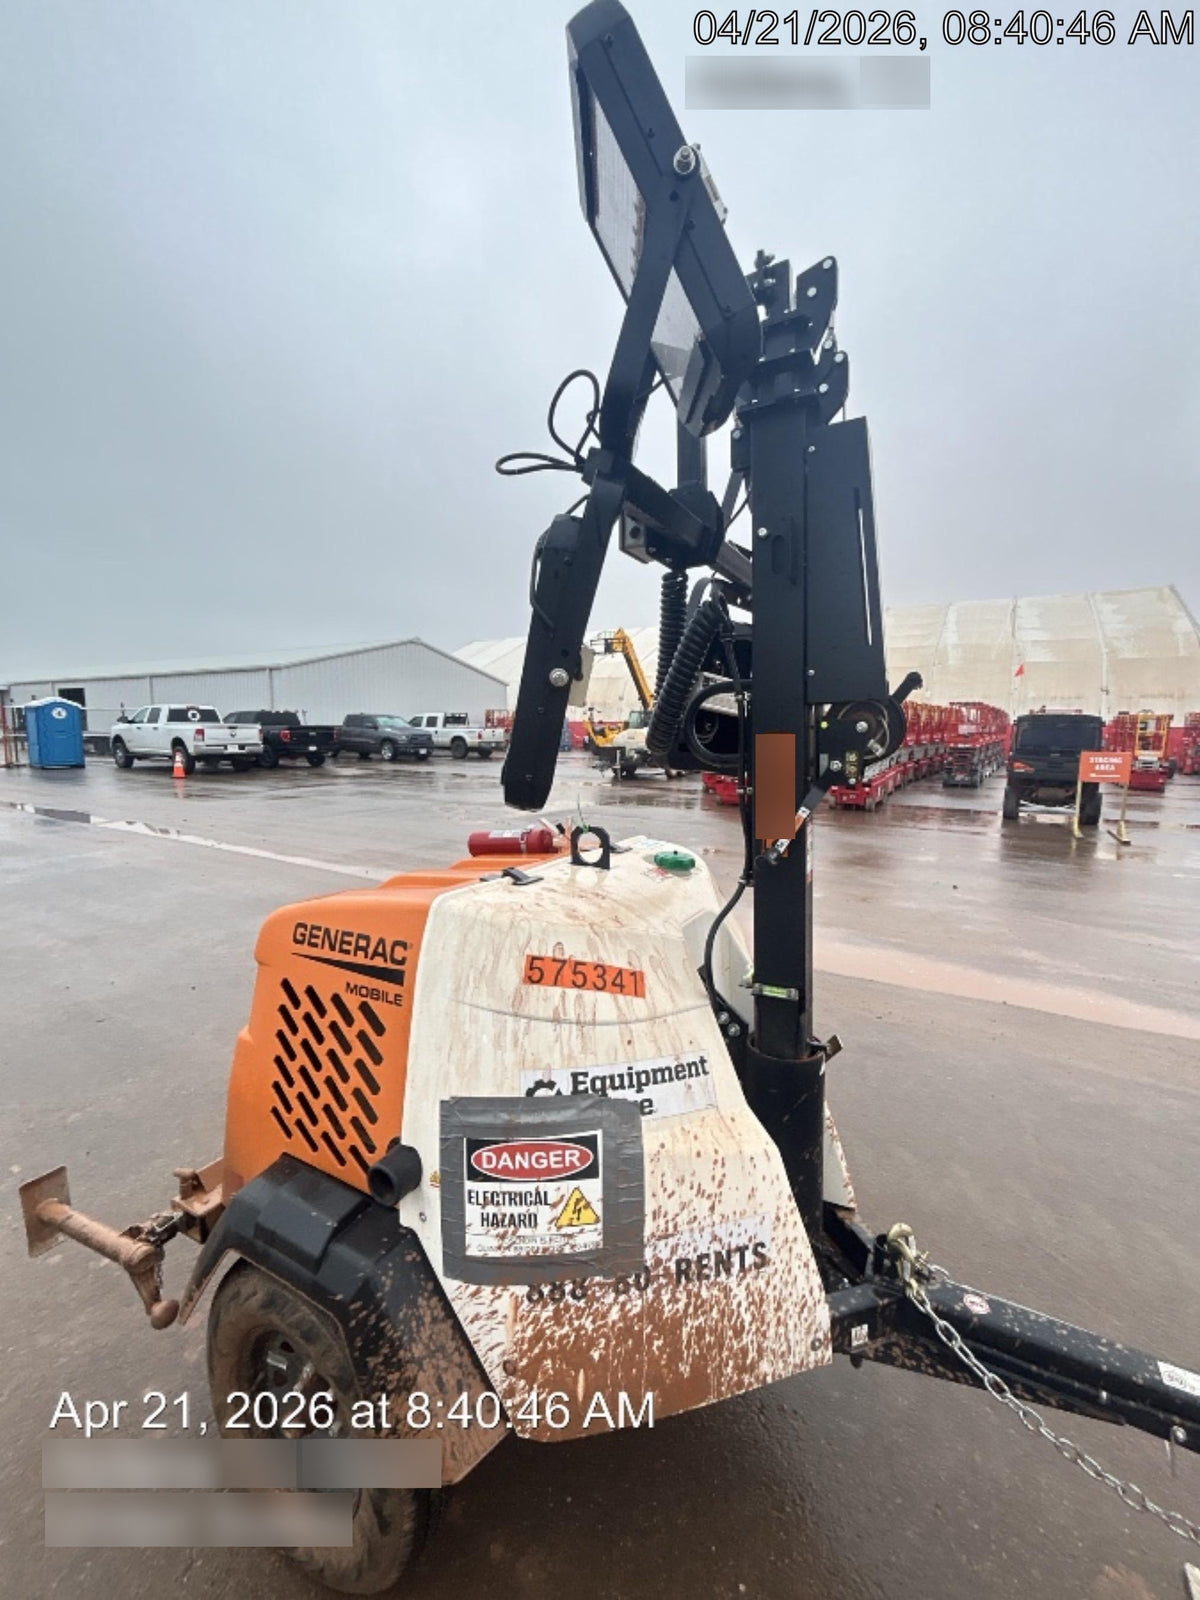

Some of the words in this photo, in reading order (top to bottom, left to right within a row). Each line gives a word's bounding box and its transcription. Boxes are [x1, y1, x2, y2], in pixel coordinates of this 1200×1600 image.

[292, 922, 408, 966] GENERAC
[527, 956, 638, 997] 575341
[345, 981, 404, 1007] MOBILE
[570, 1056, 710, 1098] Equipment
[481, 1149, 581, 1170] DANGER
[467, 1189, 552, 1207] ELECTRICAL
[480, 1212, 538, 1229] HAZARD
